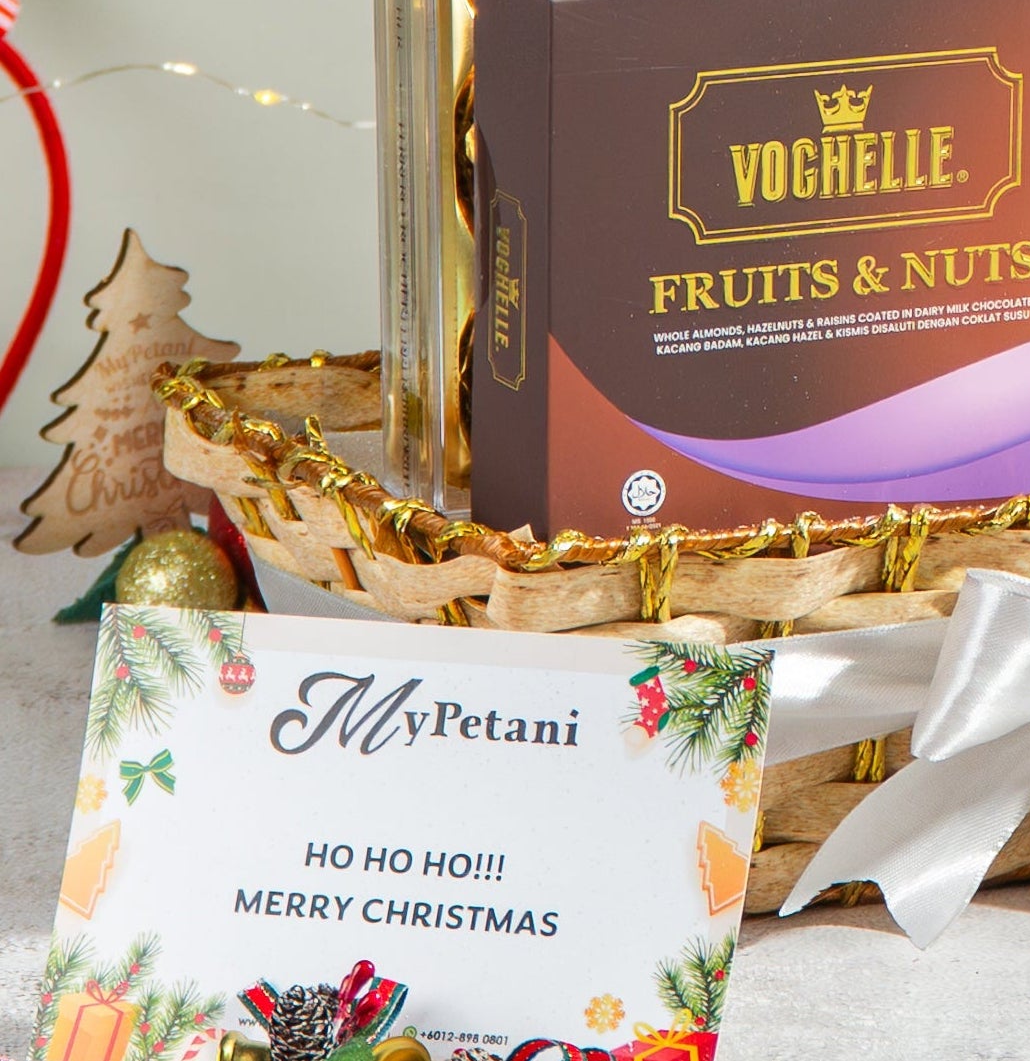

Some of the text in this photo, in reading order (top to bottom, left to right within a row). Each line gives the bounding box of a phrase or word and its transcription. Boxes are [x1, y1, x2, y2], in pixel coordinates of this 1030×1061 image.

[648, 259, 840, 315] FRUITS
[852, 255, 890, 297] &
[653, 329, 690, 343] WHOLE
[692, 325, 745, 340] ALMONDS,
[747, 318, 804, 335] HAZELNUTS
[806, 319, 814, 328] &
[816, 314, 856, 328] RAISINS
[857, 310, 899, 324] COATED
[901, 308, 913, 319] IN
[914, 305, 945, 318] DAIRY
[946, 301, 970, 315] MILK
[656, 309, 1030, 356] KACANG BADAM, KACANG HAZEL & KISMIS DISALUTI DENGAN COKLAT SUSU
[270, 671, 579, 755] MyPetani
[305, 842, 505, 881] HO HO HO!!!
[234, 889, 559, 937] MERRY CHRISTMAS
[420, 1031, 509, 1045] +6012-898 0801
